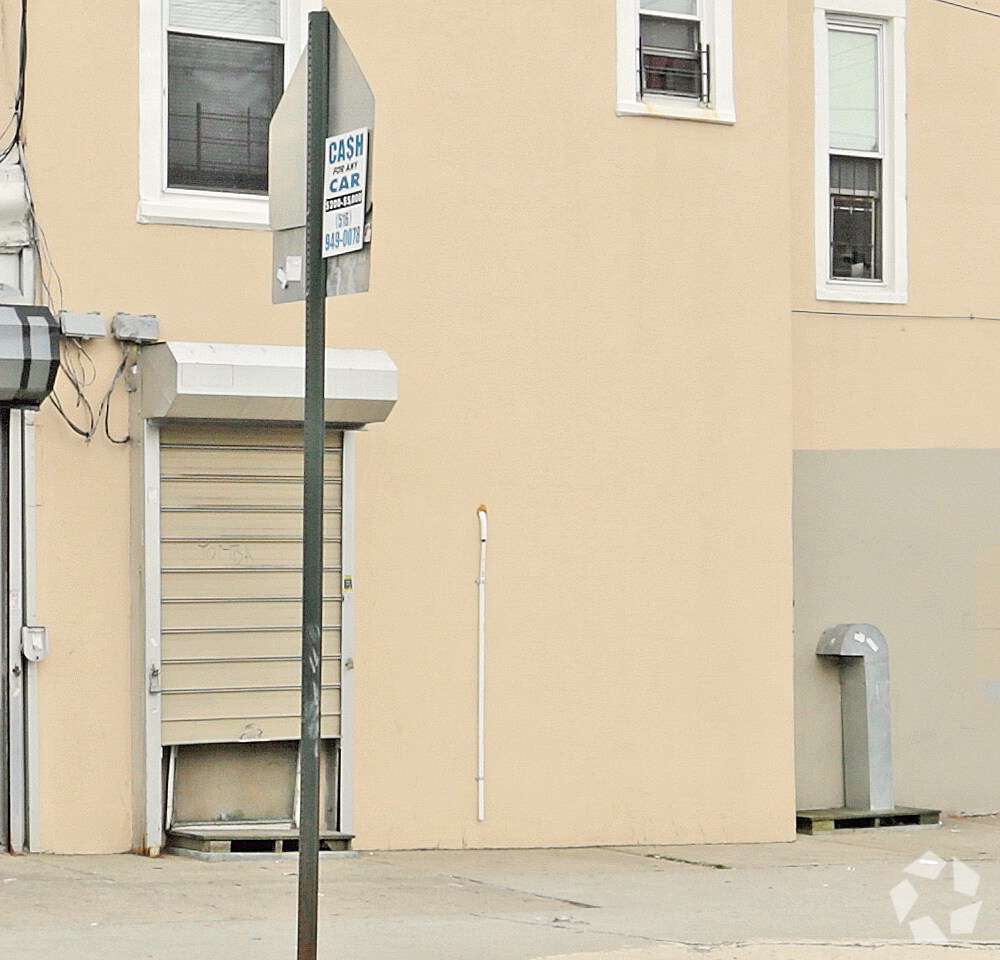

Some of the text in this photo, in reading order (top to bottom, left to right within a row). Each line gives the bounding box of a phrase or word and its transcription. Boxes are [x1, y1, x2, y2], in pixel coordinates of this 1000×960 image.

[332, 161, 358, 175] FOR ANY
[329, 172, 360, 193] CAR
